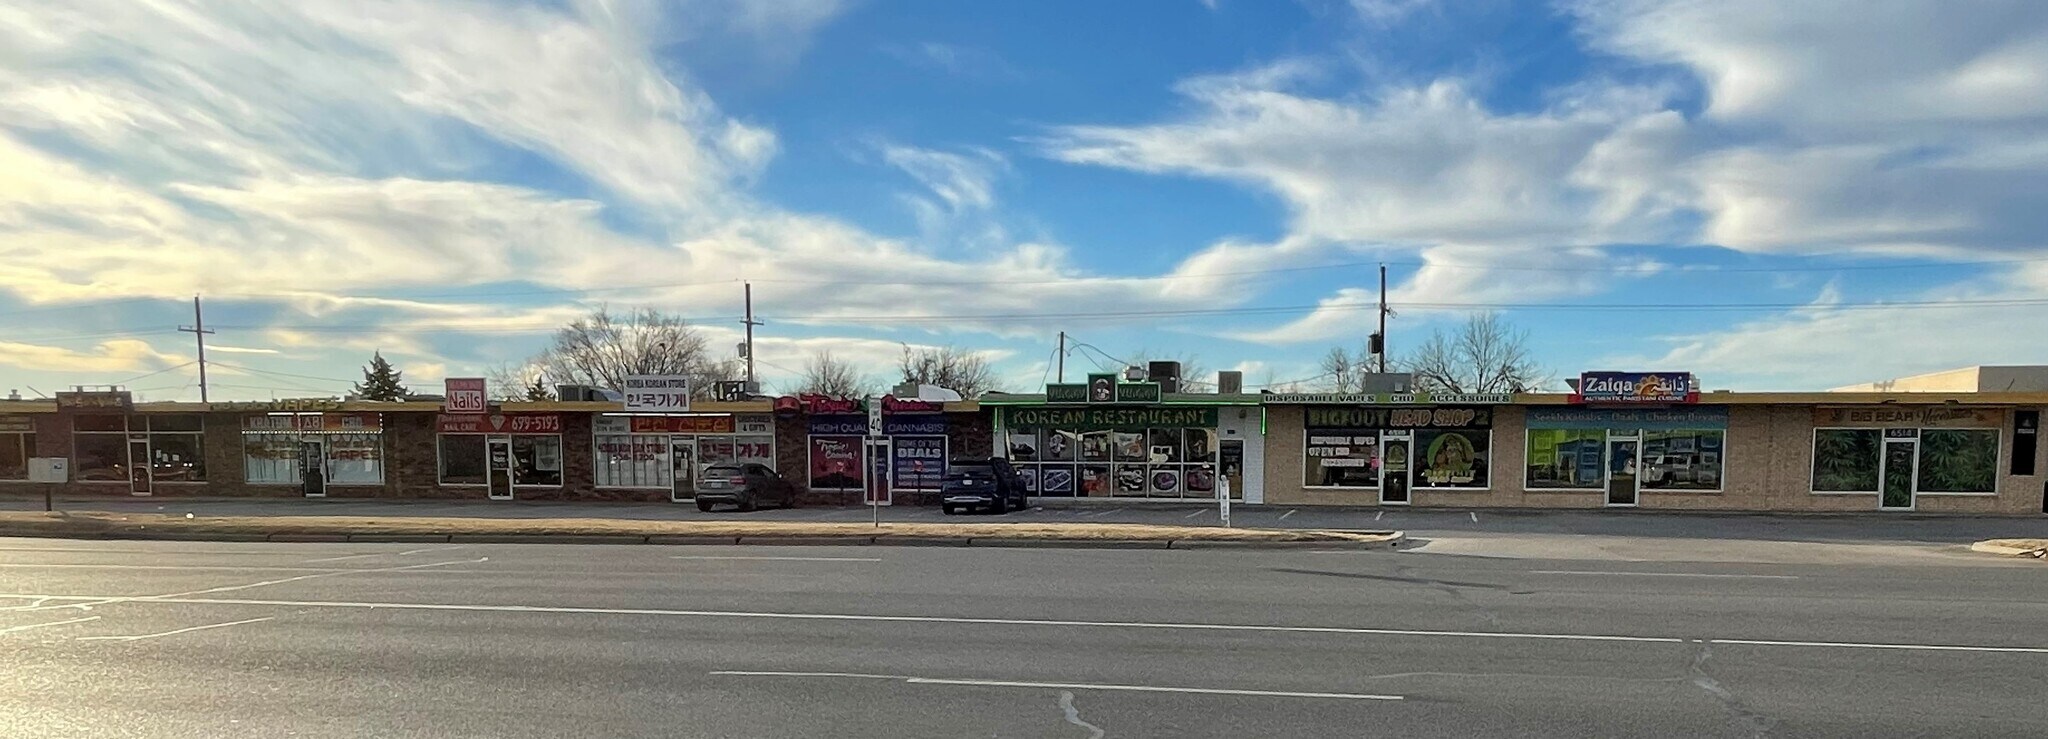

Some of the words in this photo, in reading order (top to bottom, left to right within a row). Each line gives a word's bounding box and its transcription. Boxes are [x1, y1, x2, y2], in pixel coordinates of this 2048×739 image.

[626, 379, 644, 388] KOREA
[645, 379, 667, 388] KOREAN
[669, 379, 686, 388] STORE
[1585, 378, 1634, 396] Zaiqa
[450, 392, 481, 409] Nails
[627, 393, 687, 408] 한국가게
[1339, 395, 1375, 403] VAPES
[1391, 395, 1415, 403] CBD
[1428, 394, 1511, 402] ACCESSORIES
[1013, 409, 1086, 425] KOREAN
[1093, 409, 1209, 424] RESTAURANT
[1308, 409, 1388, 426] BIGFOOT
[1390, 409, 1432, 427] HEAD
[1432, 409, 1475, 426] SHOP
[1851, 411, 1872, 422] BIG
[1876, 411, 1914, 422] BEAR
[511, 416, 559, 430] 699-5193
[812, 424, 839, 433] HIGH
[888, 423, 945, 433] CANNABIS
[870, 418, 881, 431] 40
[896, 440, 917, 448] HOME
[897, 447, 942, 458] DEALS
[1309, 447, 1334, 457] OPEN
